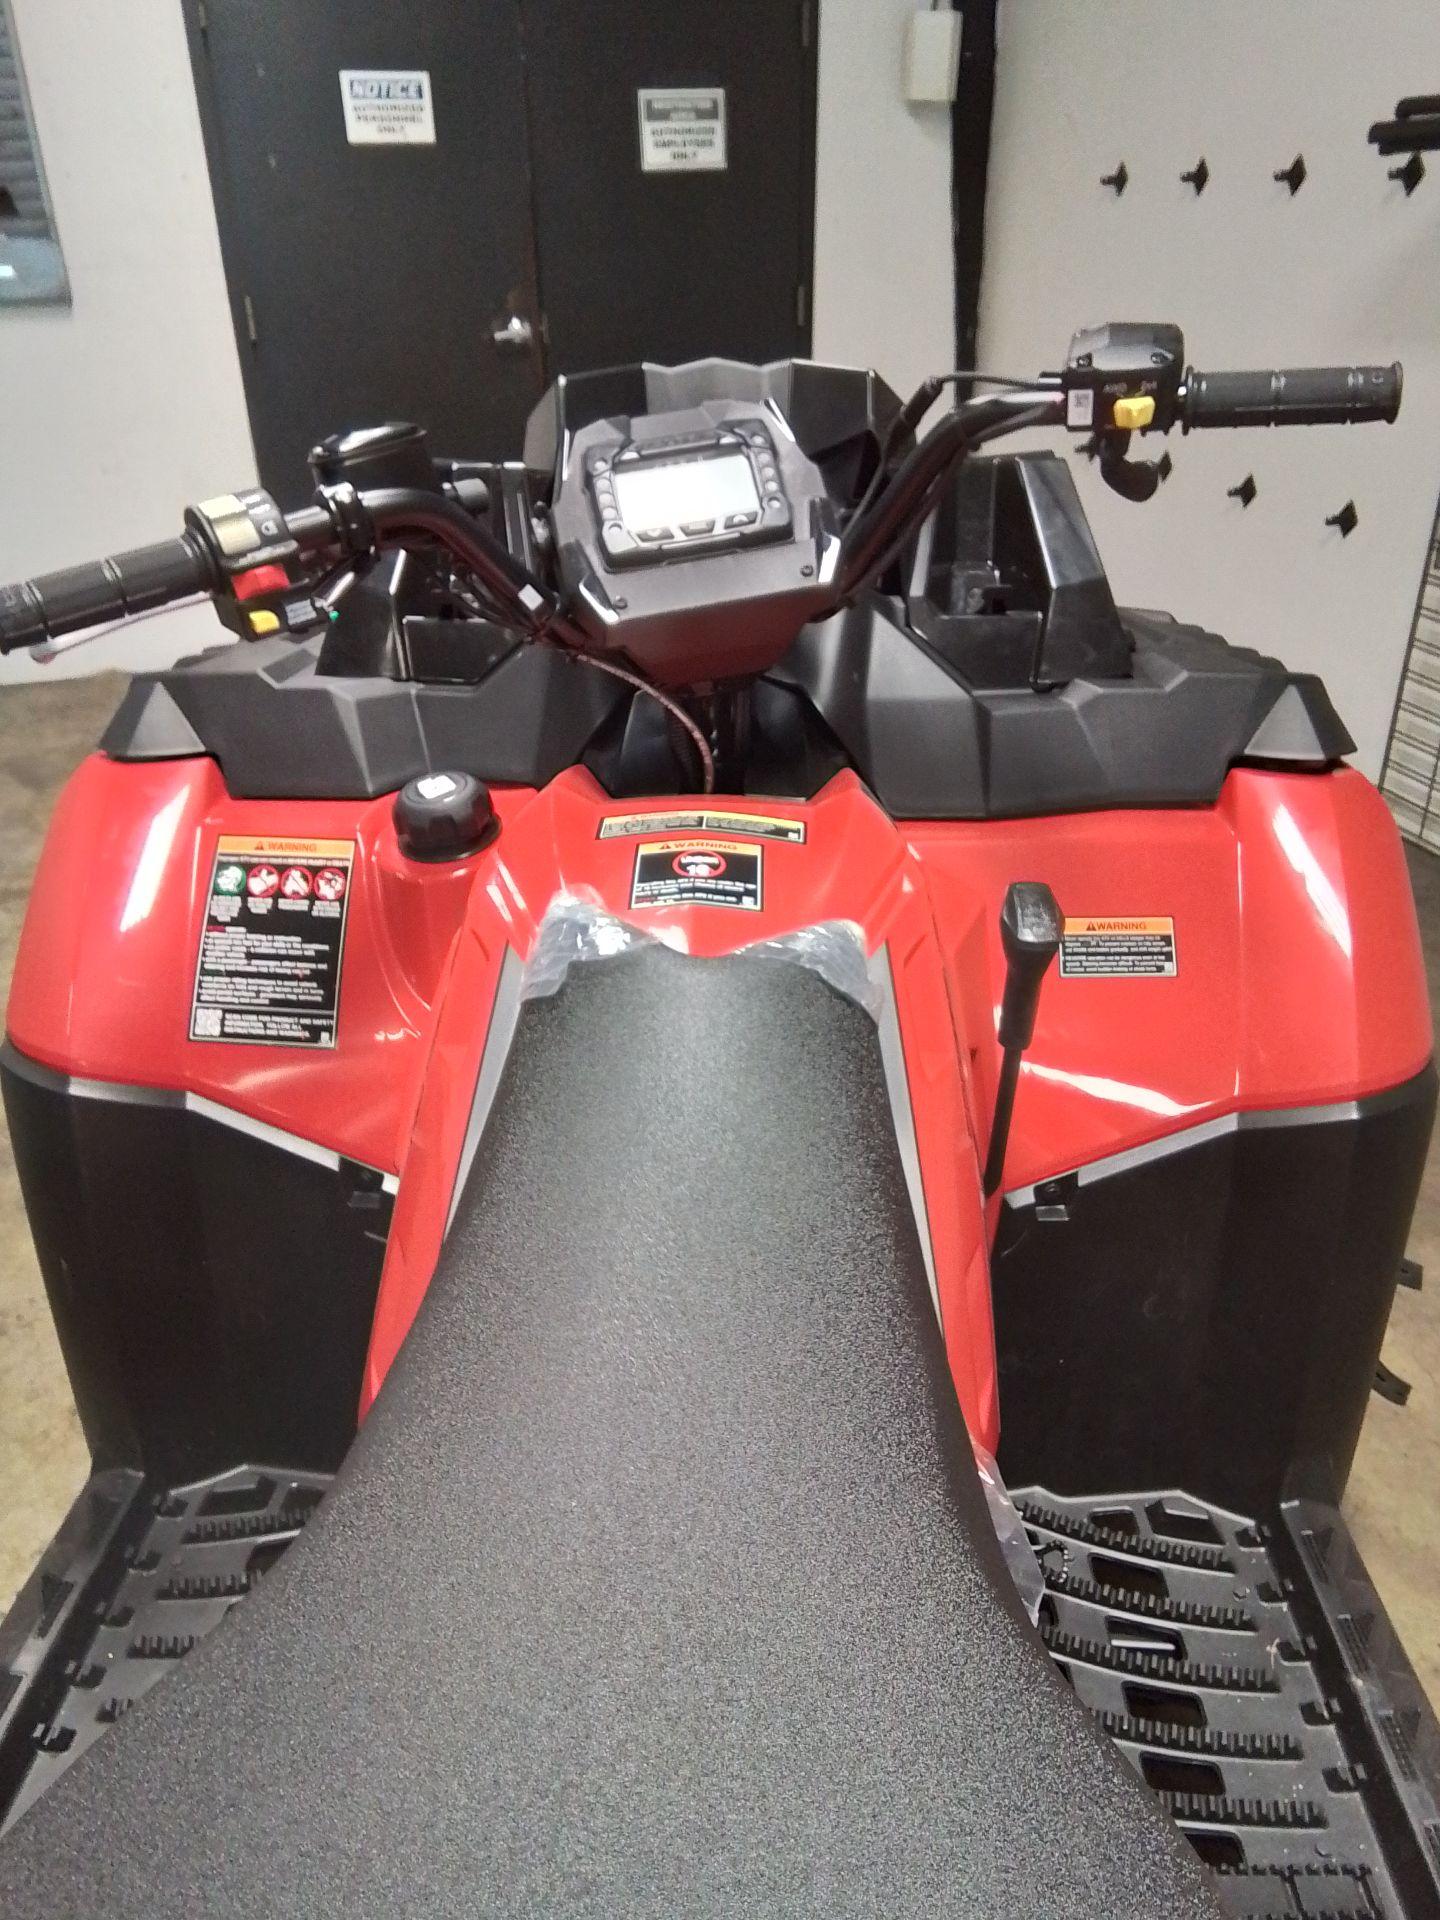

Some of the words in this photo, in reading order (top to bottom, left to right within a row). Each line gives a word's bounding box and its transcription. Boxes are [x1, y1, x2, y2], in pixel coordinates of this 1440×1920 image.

[268, 841, 317, 851] WARNING
[674, 842, 738, 850] WARNING
[1097, 922, 1147, 930] WARNING
